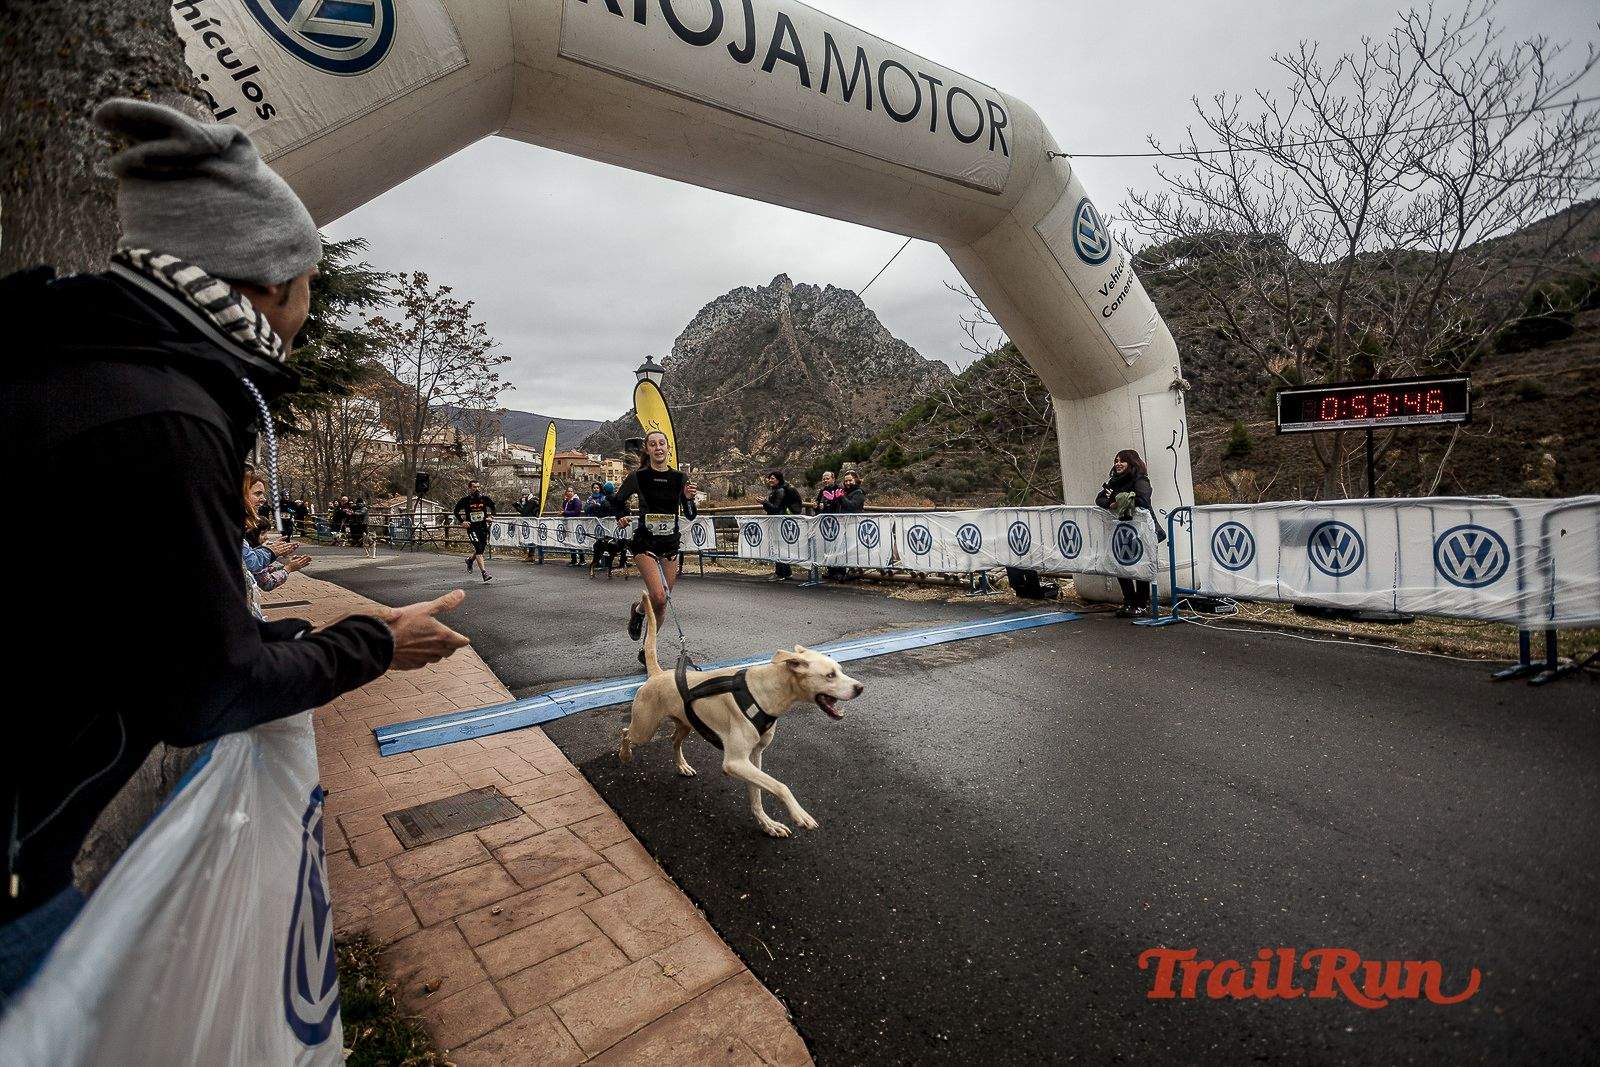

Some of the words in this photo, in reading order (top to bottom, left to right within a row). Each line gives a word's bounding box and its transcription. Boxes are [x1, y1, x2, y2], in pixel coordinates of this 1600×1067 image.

[173, 0, 276, 121] hículos
[578, 0, 1010, 157] OJAMOTOR
[1321, 389, 1444, 421] 0:59:46
[659, 523, 668, 531] 12
